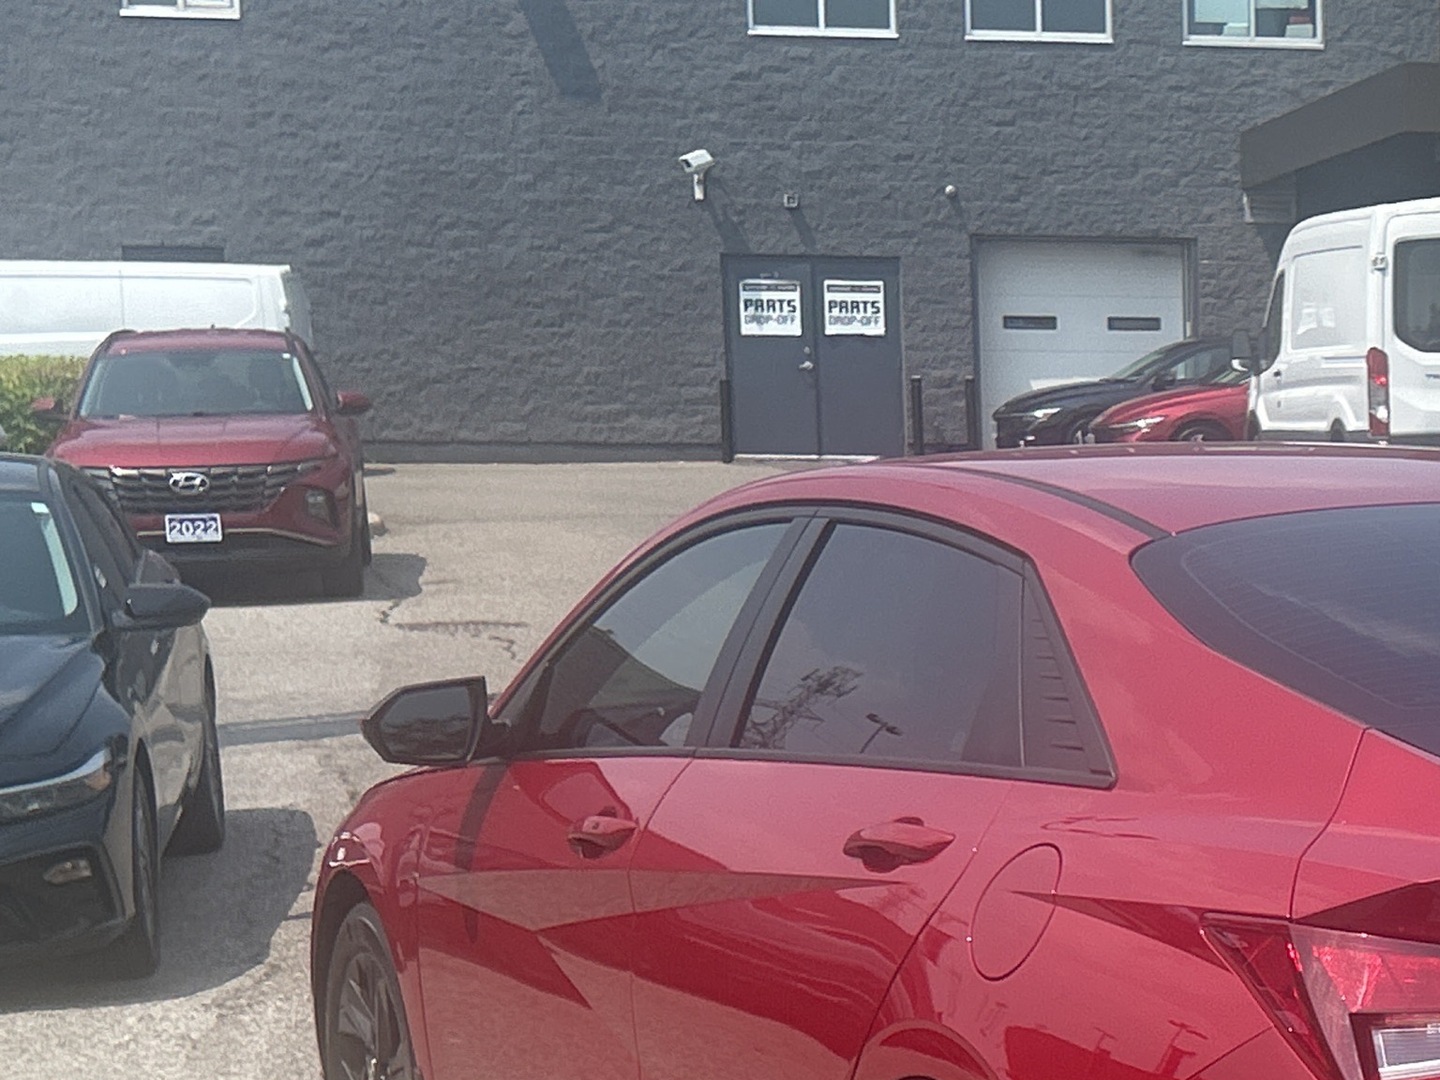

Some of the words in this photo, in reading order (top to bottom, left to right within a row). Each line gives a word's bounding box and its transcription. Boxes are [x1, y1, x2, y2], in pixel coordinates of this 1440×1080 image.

[743, 298, 797, 314] PARTS
[827, 300, 881, 315] PARTS
[169, 520, 219, 539] 2022
